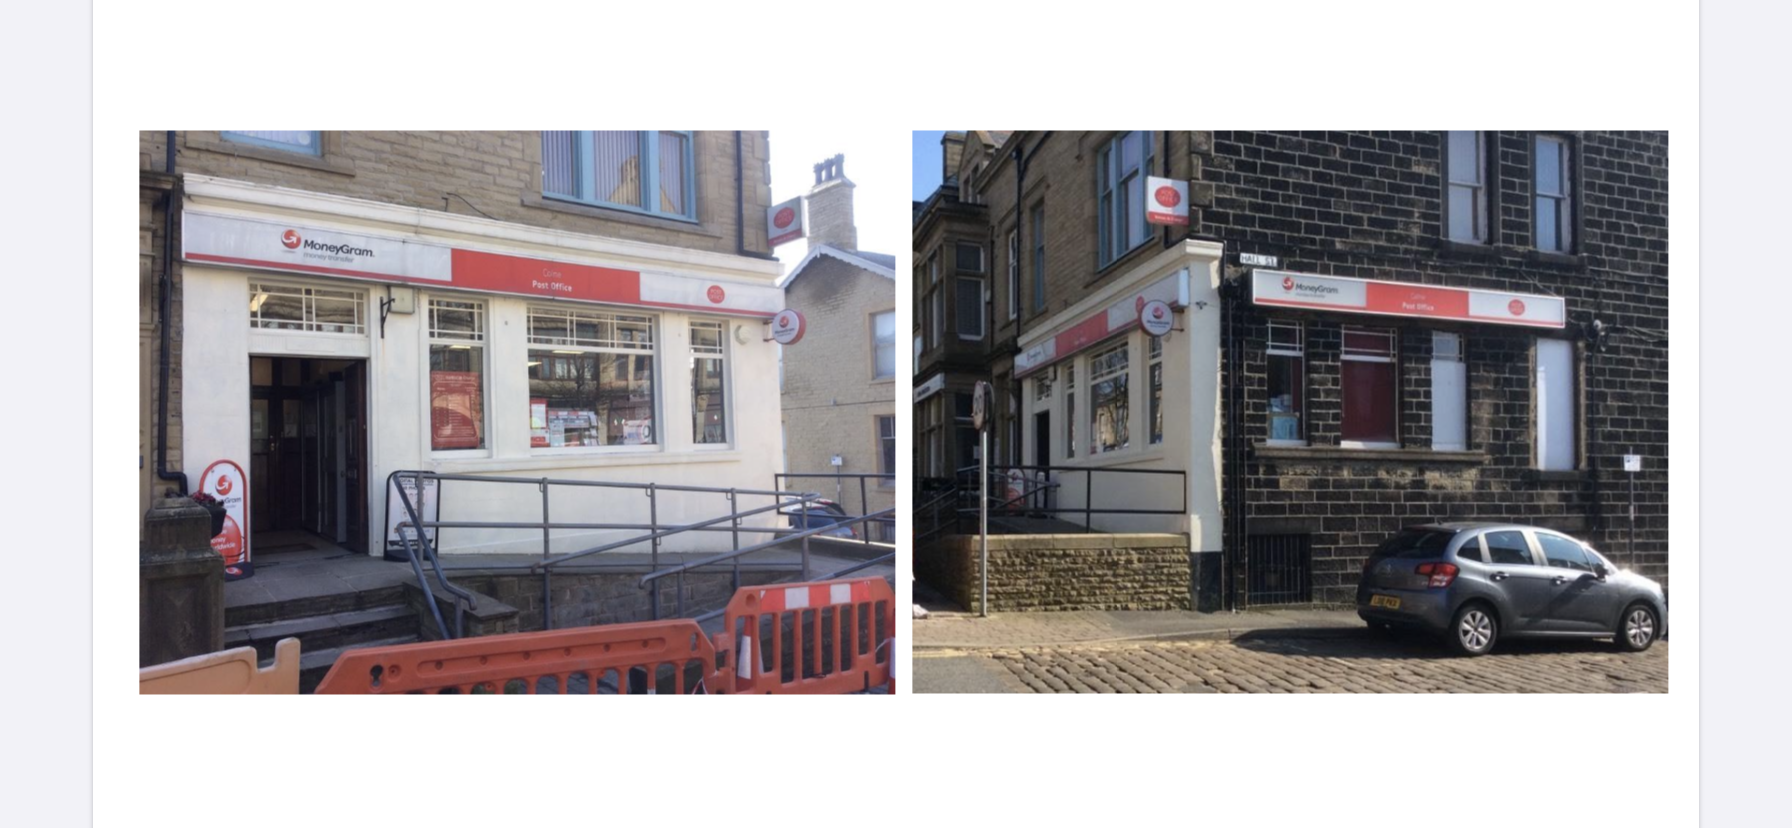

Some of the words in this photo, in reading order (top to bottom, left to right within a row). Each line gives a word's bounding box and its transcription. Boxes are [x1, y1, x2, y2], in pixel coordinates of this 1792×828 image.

[303, 252, 327, 261] money
[327, 254, 354, 262] transfer
[1241, 254, 1260, 265] HALL
[532, 280, 549, 290] Post
[551, 282, 573, 292] Office
[1295, 282, 1339, 294] MoneyGram
[1402, 301, 1415, 310] Post
[1416, 303, 1435, 312] Office
[211, 536, 226, 545] oney
